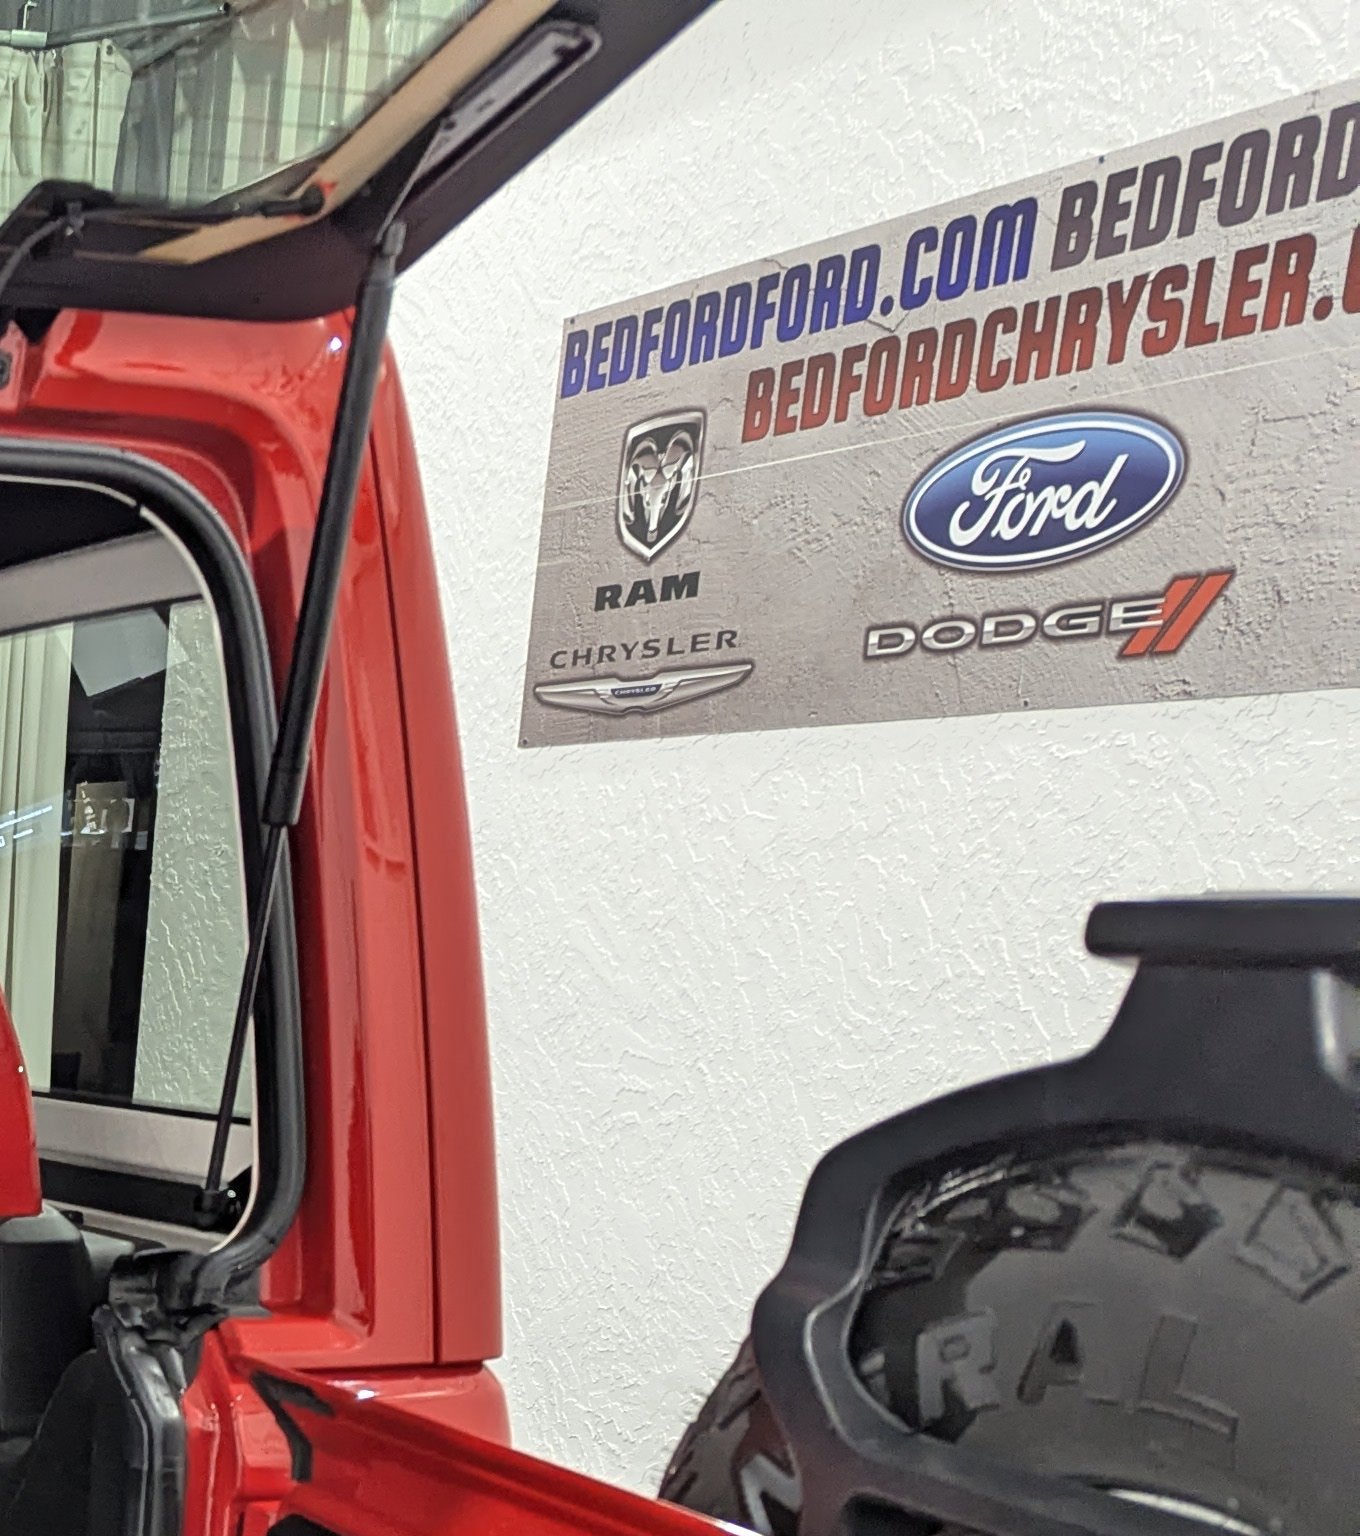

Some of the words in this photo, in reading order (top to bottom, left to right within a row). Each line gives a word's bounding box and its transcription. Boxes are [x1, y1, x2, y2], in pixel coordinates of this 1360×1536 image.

[561, 197, 1038, 399] BEDFORDFORD.COM
[1050, 101, 1360, 272] BEDFORD
[948, 439, 1129, 546] Ford
[594, 571, 701, 612] RAM
[550, 630, 739, 669] CHRYSLER
[864, 597, 1166, 657] DODGE
